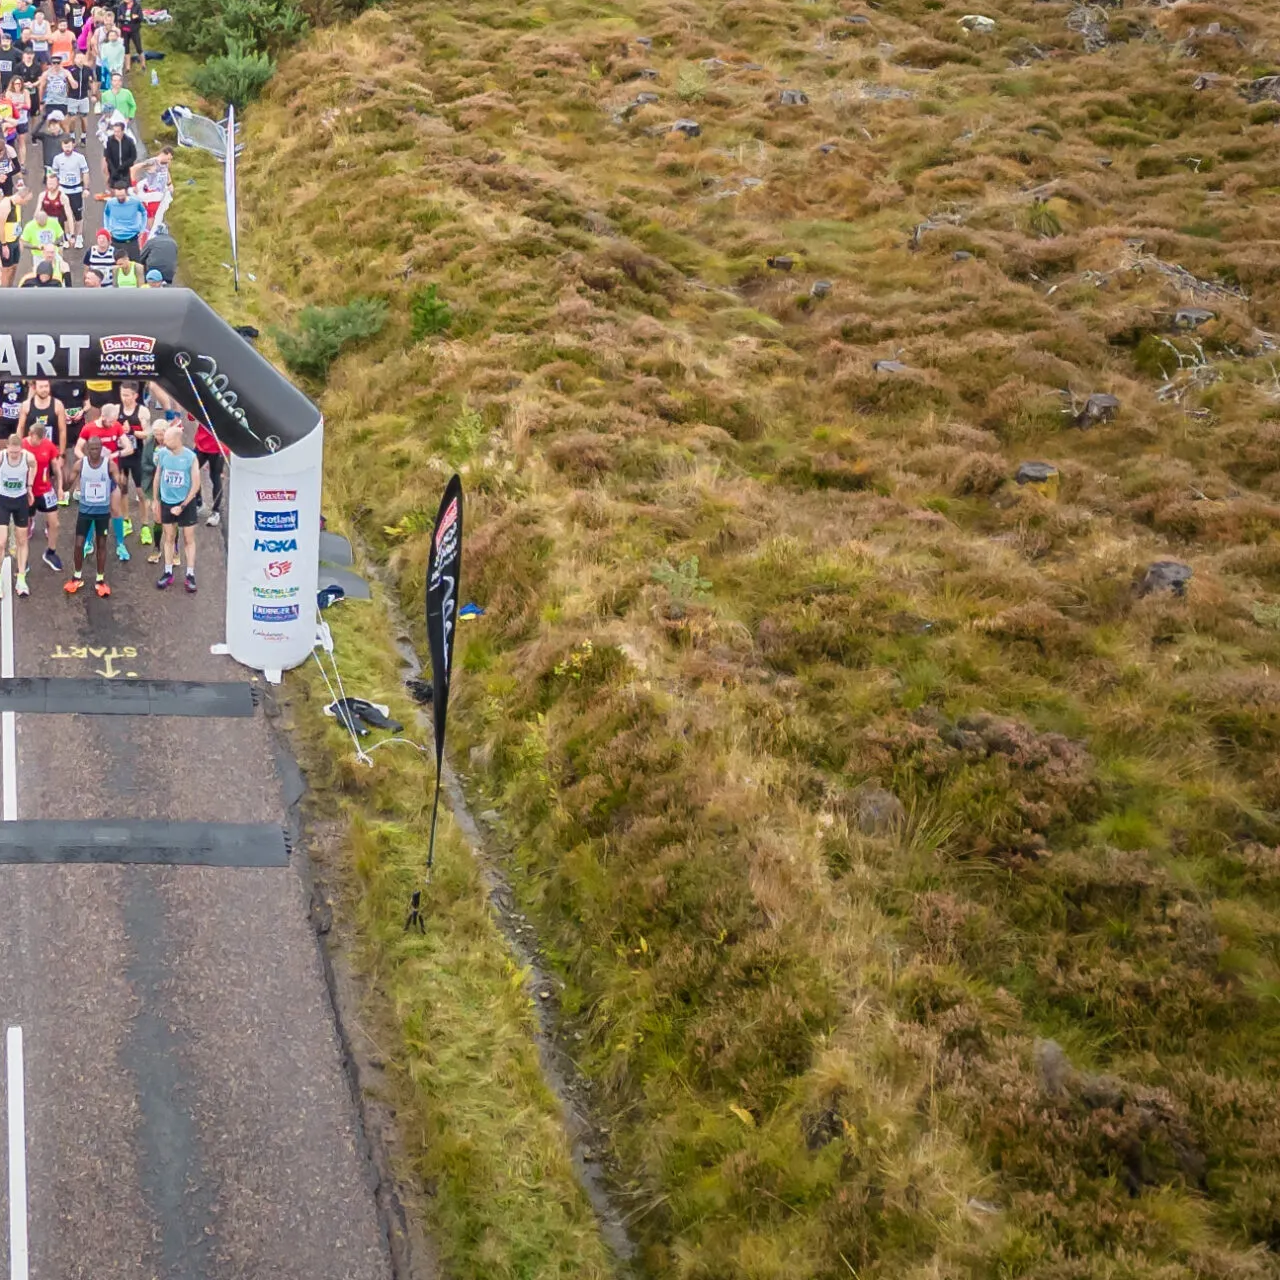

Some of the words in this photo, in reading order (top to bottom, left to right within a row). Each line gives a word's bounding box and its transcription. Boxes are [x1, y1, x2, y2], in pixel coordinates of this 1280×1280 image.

[104, 337, 151, 350] Baxters
[100, 353, 129, 362] LOCH
[132, 353, 155, 362] NESS
[257, 513, 297, 524] Scotland
[253, 538, 298, 552] HOKA
[50, 644, 138, 658] START
